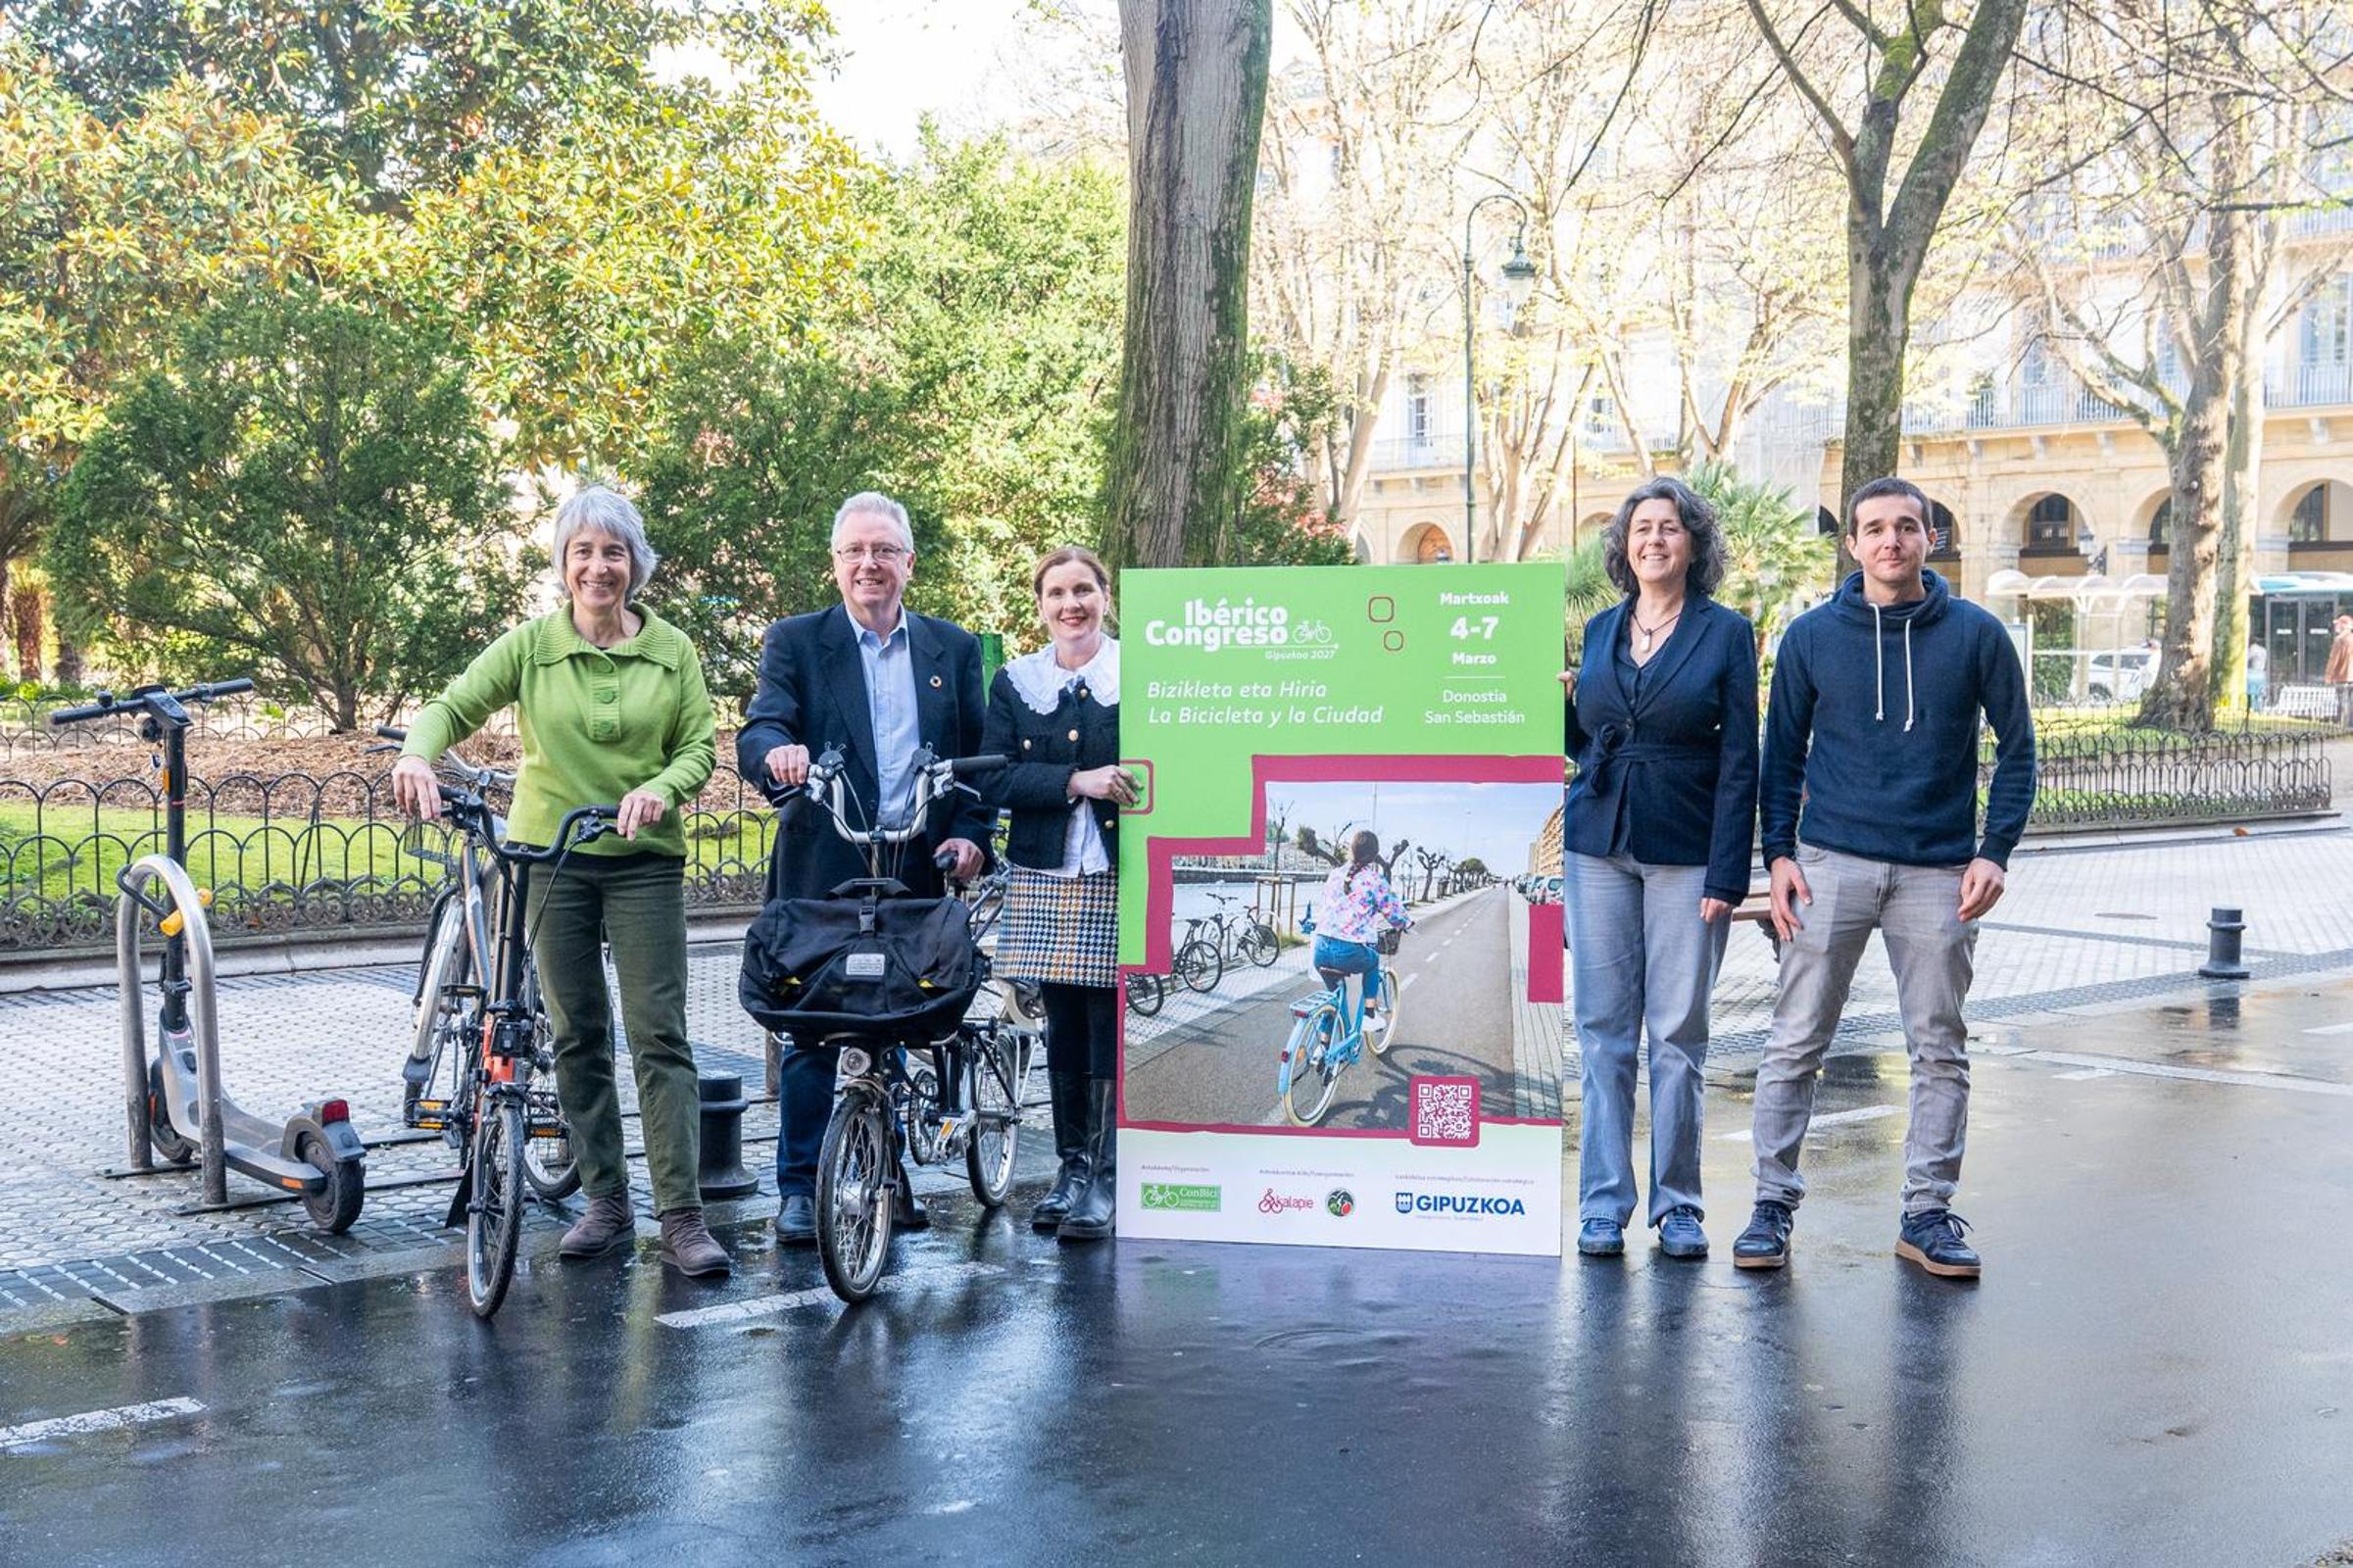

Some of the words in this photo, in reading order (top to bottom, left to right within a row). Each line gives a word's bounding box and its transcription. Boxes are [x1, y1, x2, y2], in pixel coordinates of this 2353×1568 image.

[1440, 591, 1510, 605] Martxoak
[1185, 596, 1289, 626] Ibérico
[1146, 619, 1289, 652] Congreso
[1450, 616, 1499, 640] 4-7
[1310, 650, 1336, 660] 2027
[1452, 652, 1497, 664] Marzo
[1148, 680, 1233, 698] Bizikleta
[1240, 683, 1272, 698] eta
[1279, 680, 1328, 698] Hiria
[1443, 689, 1507, 703] Donostia
[1149, 707, 1171, 723] La
[1179, 706, 1264, 723] Bicicleta
[1267, 710, 1282, 728] y
[1288, 706, 1305, 723] la
[1313, 706, 1384, 723] Ciudad
[1425, 710, 1451, 724] San
[1455, 710, 1525, 724] Sebastián
[1416, 1195, 1526, 1215] GIPUZKOA
